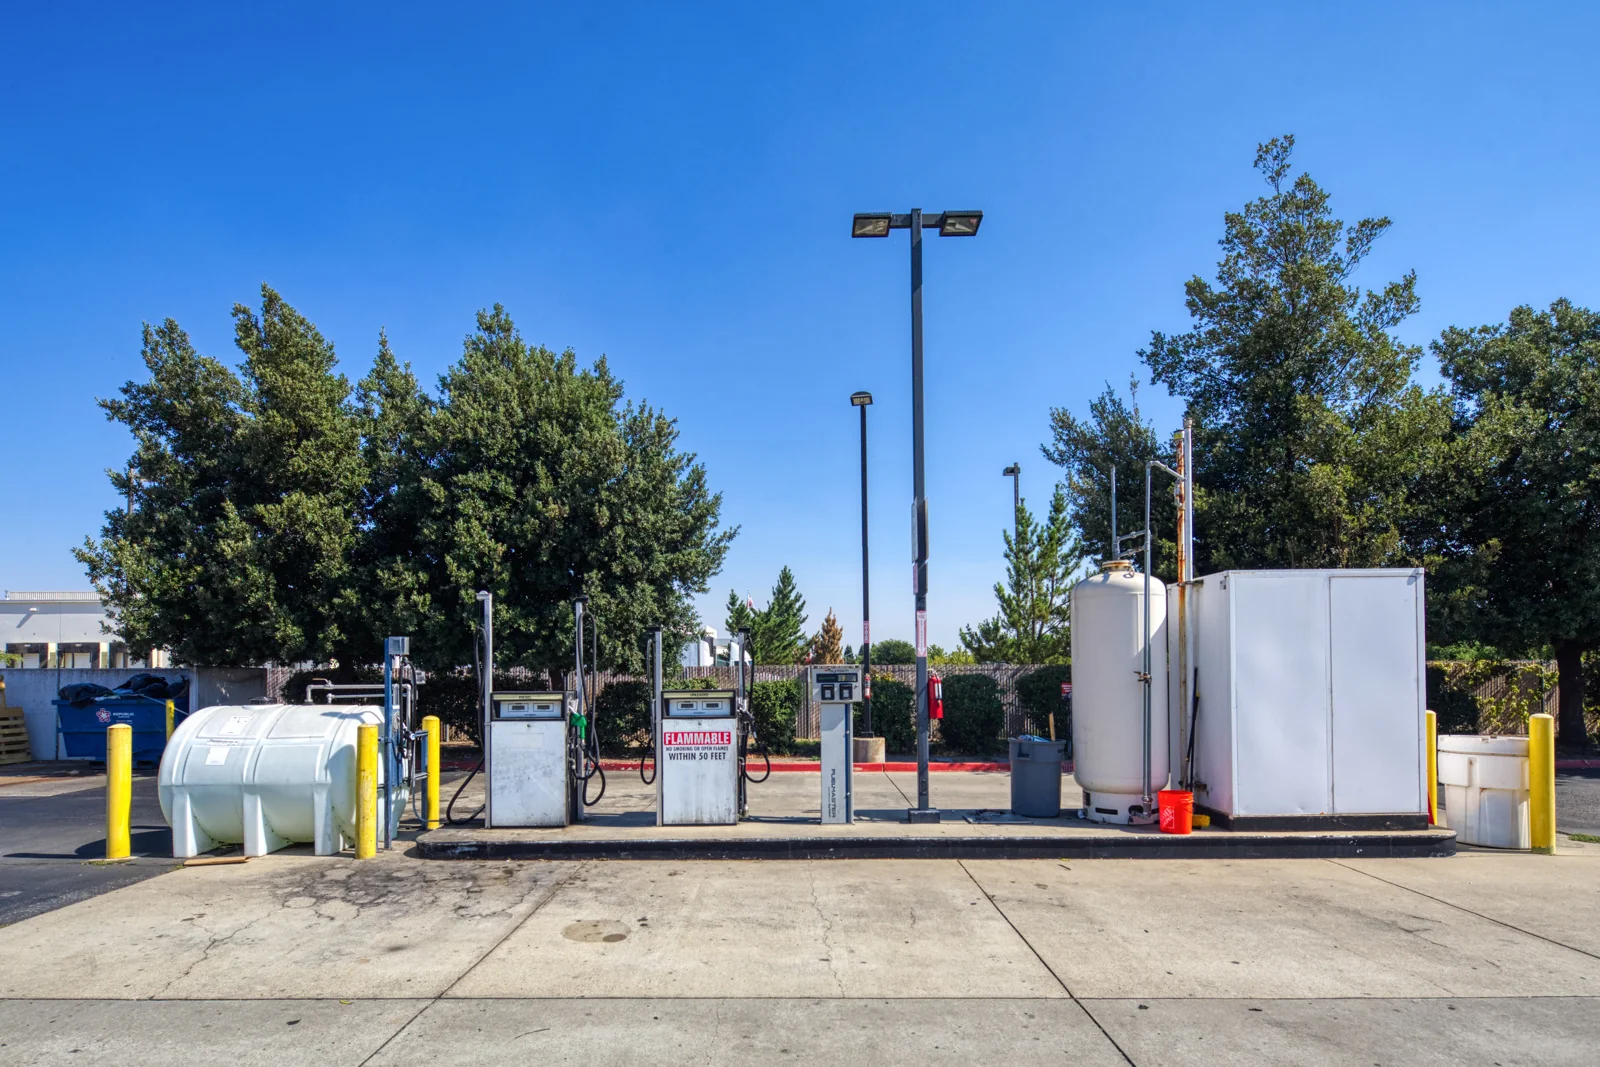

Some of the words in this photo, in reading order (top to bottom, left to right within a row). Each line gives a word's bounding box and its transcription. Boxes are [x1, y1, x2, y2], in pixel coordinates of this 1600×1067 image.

[665, 732, 730, 744] FLAMMABLE
[669, 752, 696, 760] WITHIN
[699, 752, 708, 760] 50
[711, 752, 726, 760] FEET
